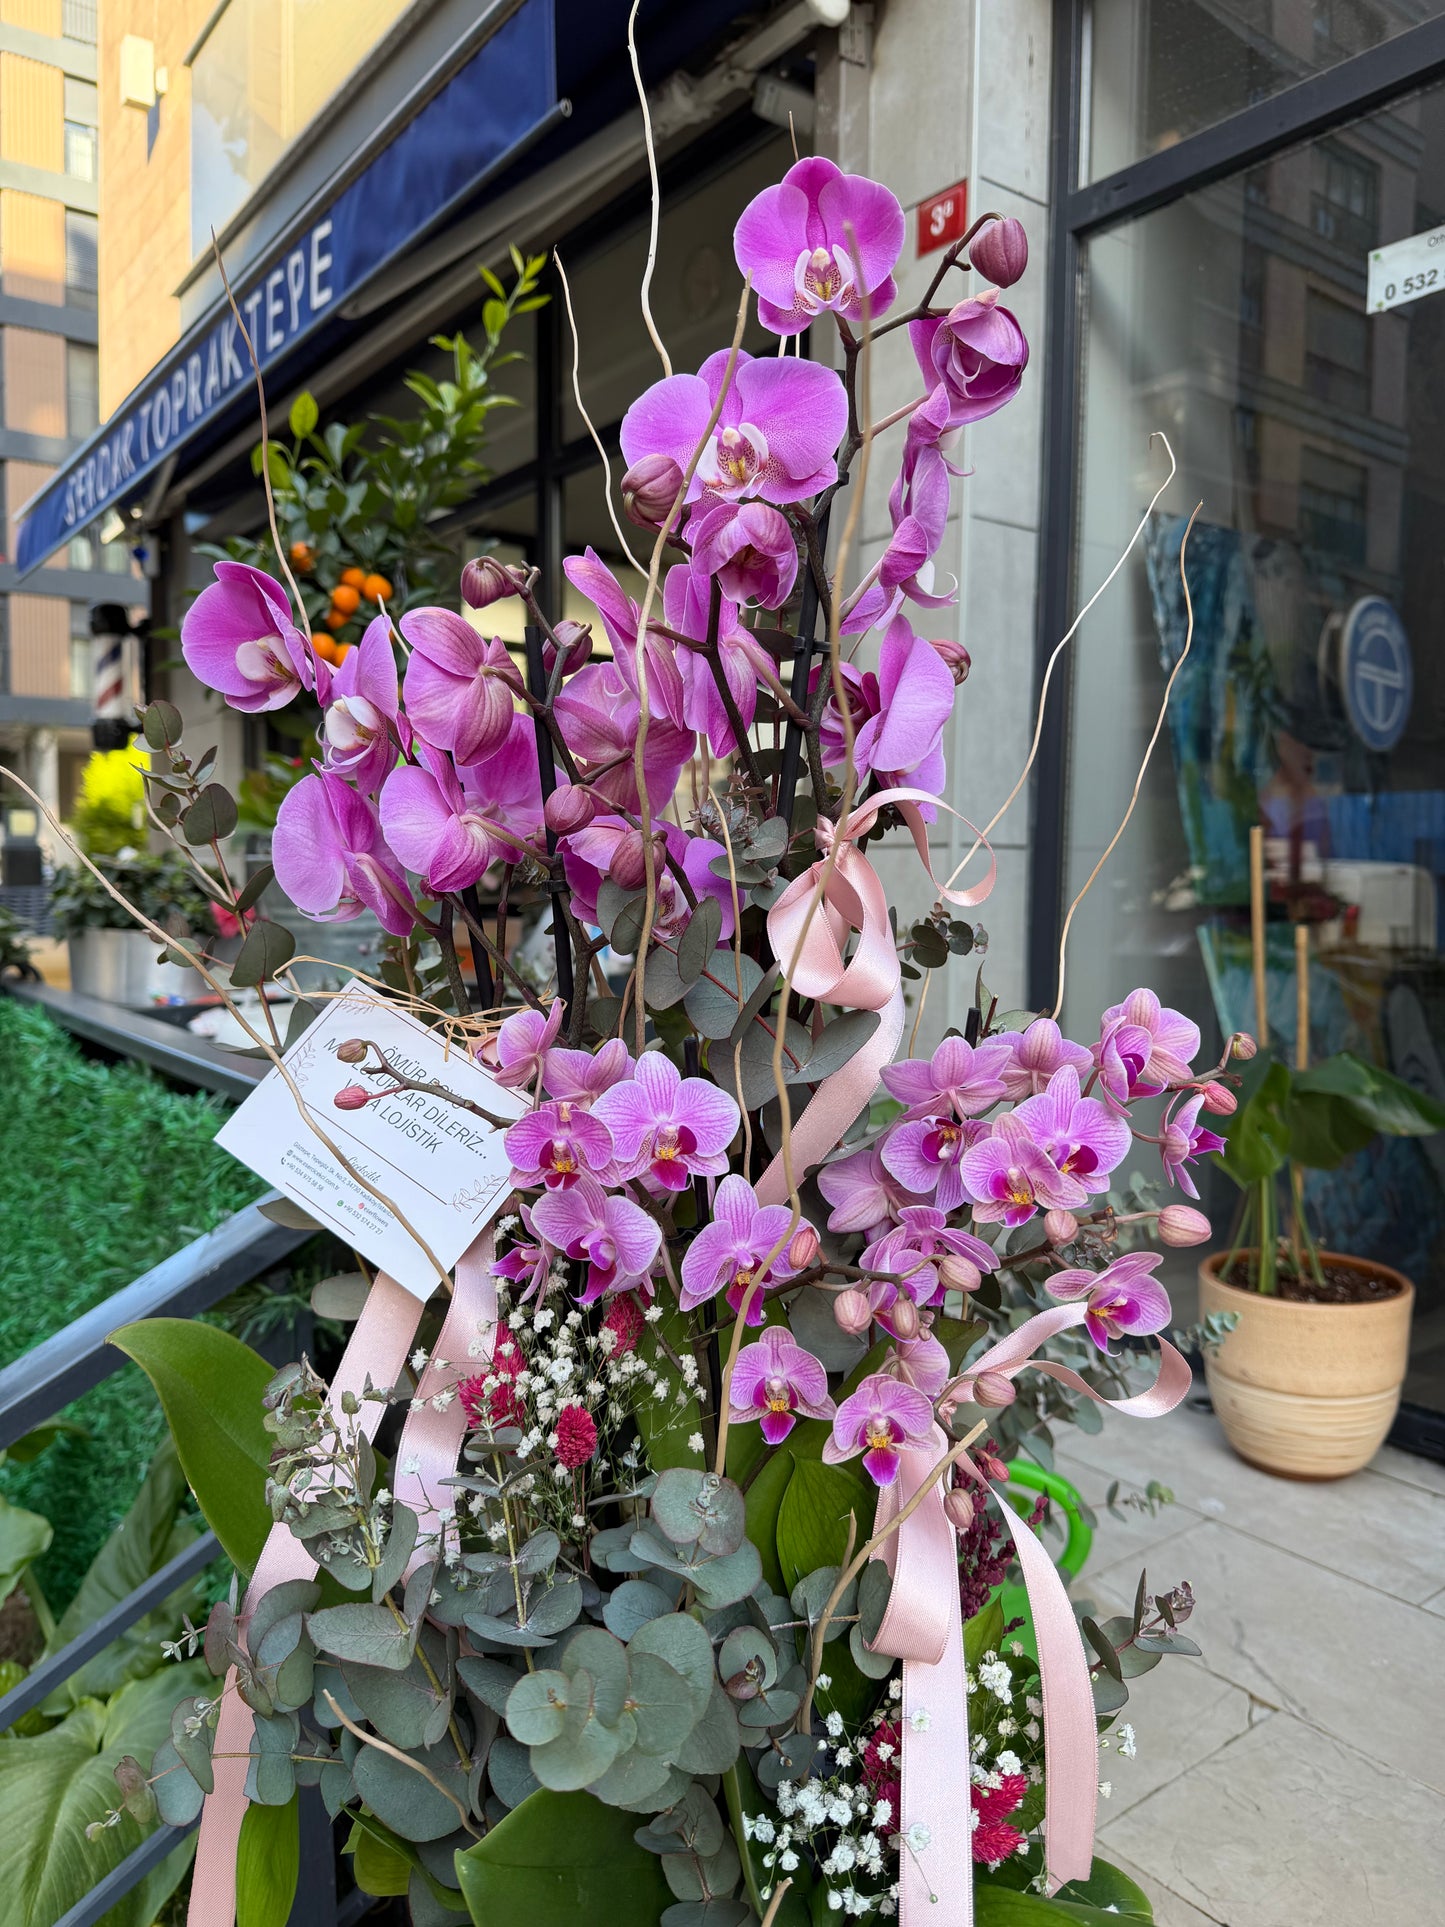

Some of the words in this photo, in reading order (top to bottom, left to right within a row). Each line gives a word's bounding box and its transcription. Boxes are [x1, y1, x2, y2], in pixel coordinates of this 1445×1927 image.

[1385, 283, 1396, 300] 0
[1403, 269, 1438, 295] 532
[382, 1045, 427, 1082] ÖMÜR
[378, 1105, 444, 1154] LOJİSTİK
[423, 1105, 487, 1159] DİLERİZ...
